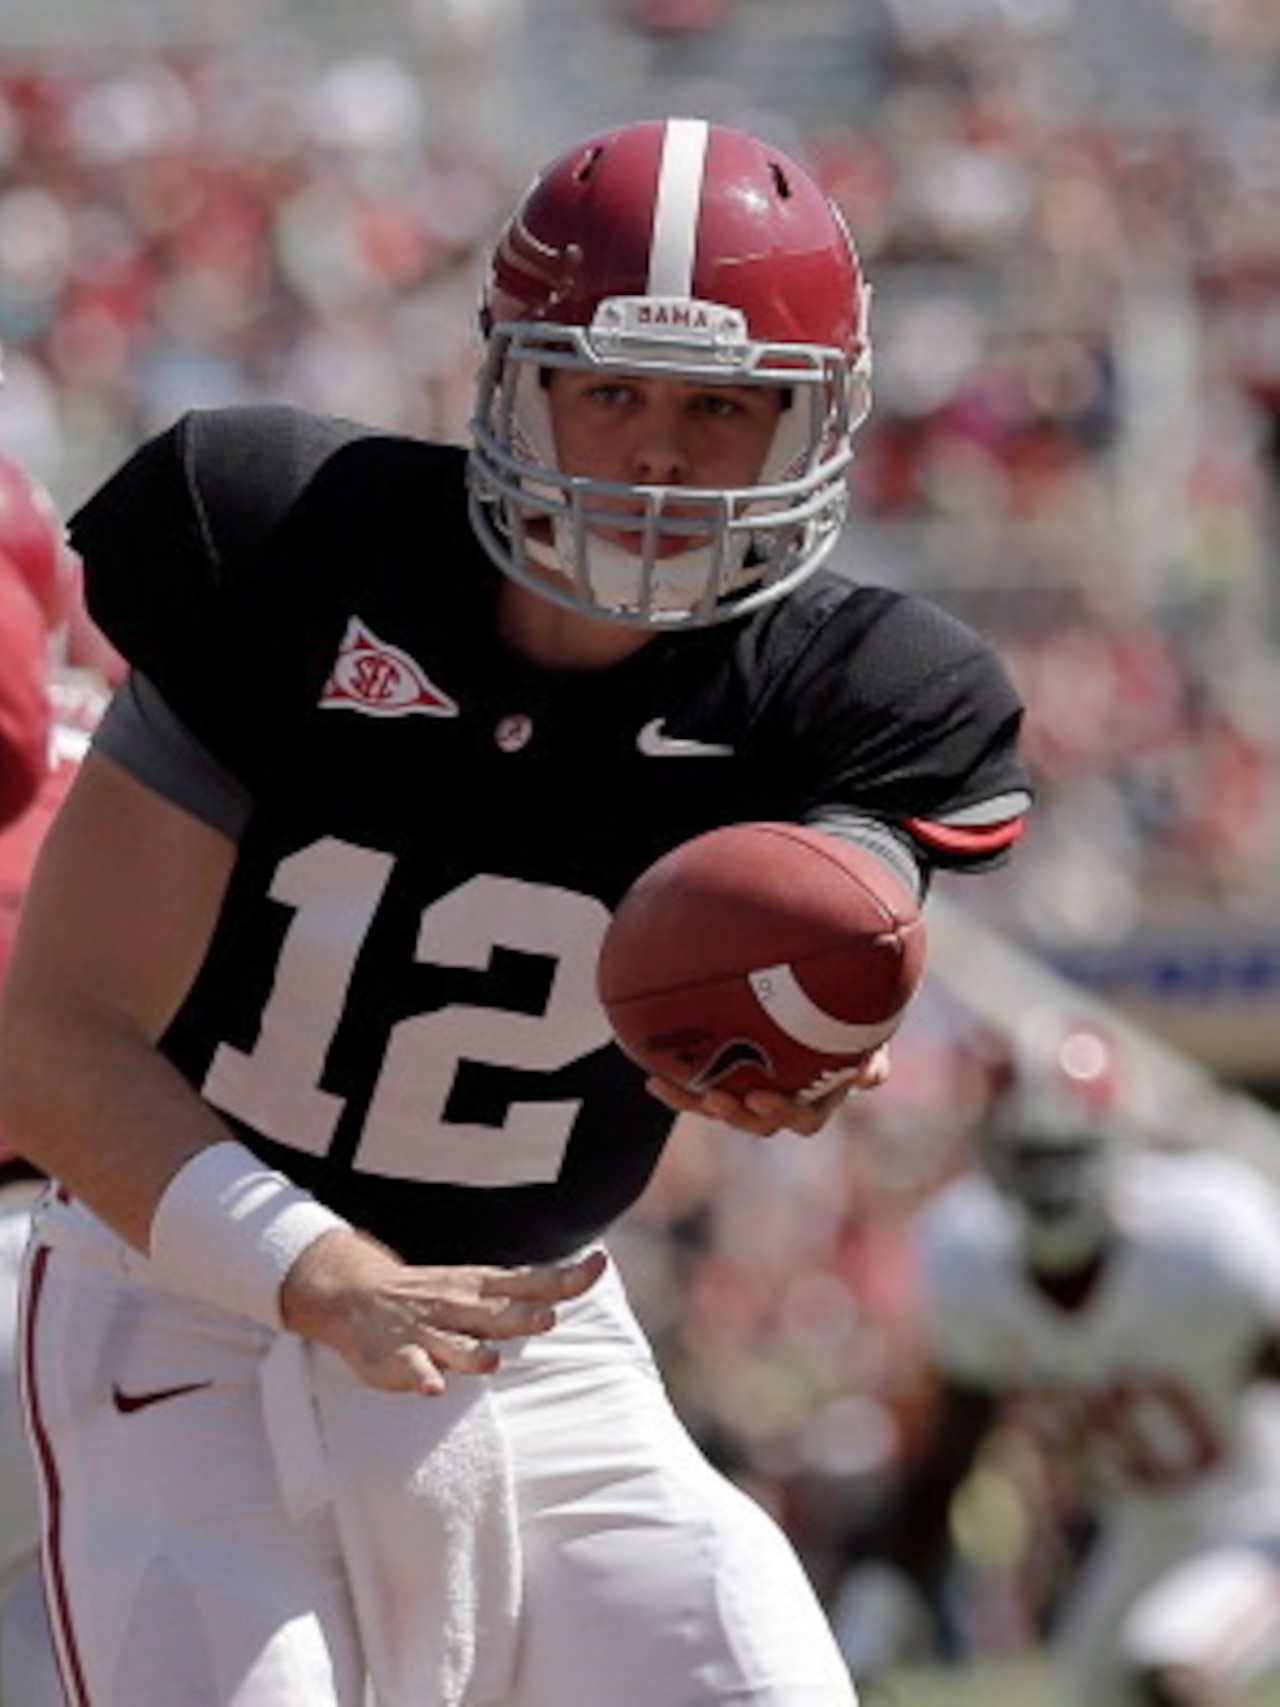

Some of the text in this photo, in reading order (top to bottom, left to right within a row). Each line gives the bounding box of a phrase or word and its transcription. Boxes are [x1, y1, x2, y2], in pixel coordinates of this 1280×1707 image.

[637, 305, 709, 328] BAMA
[350, 656, 401, 700] SEC
[201, 834, 617, 1189] 12
